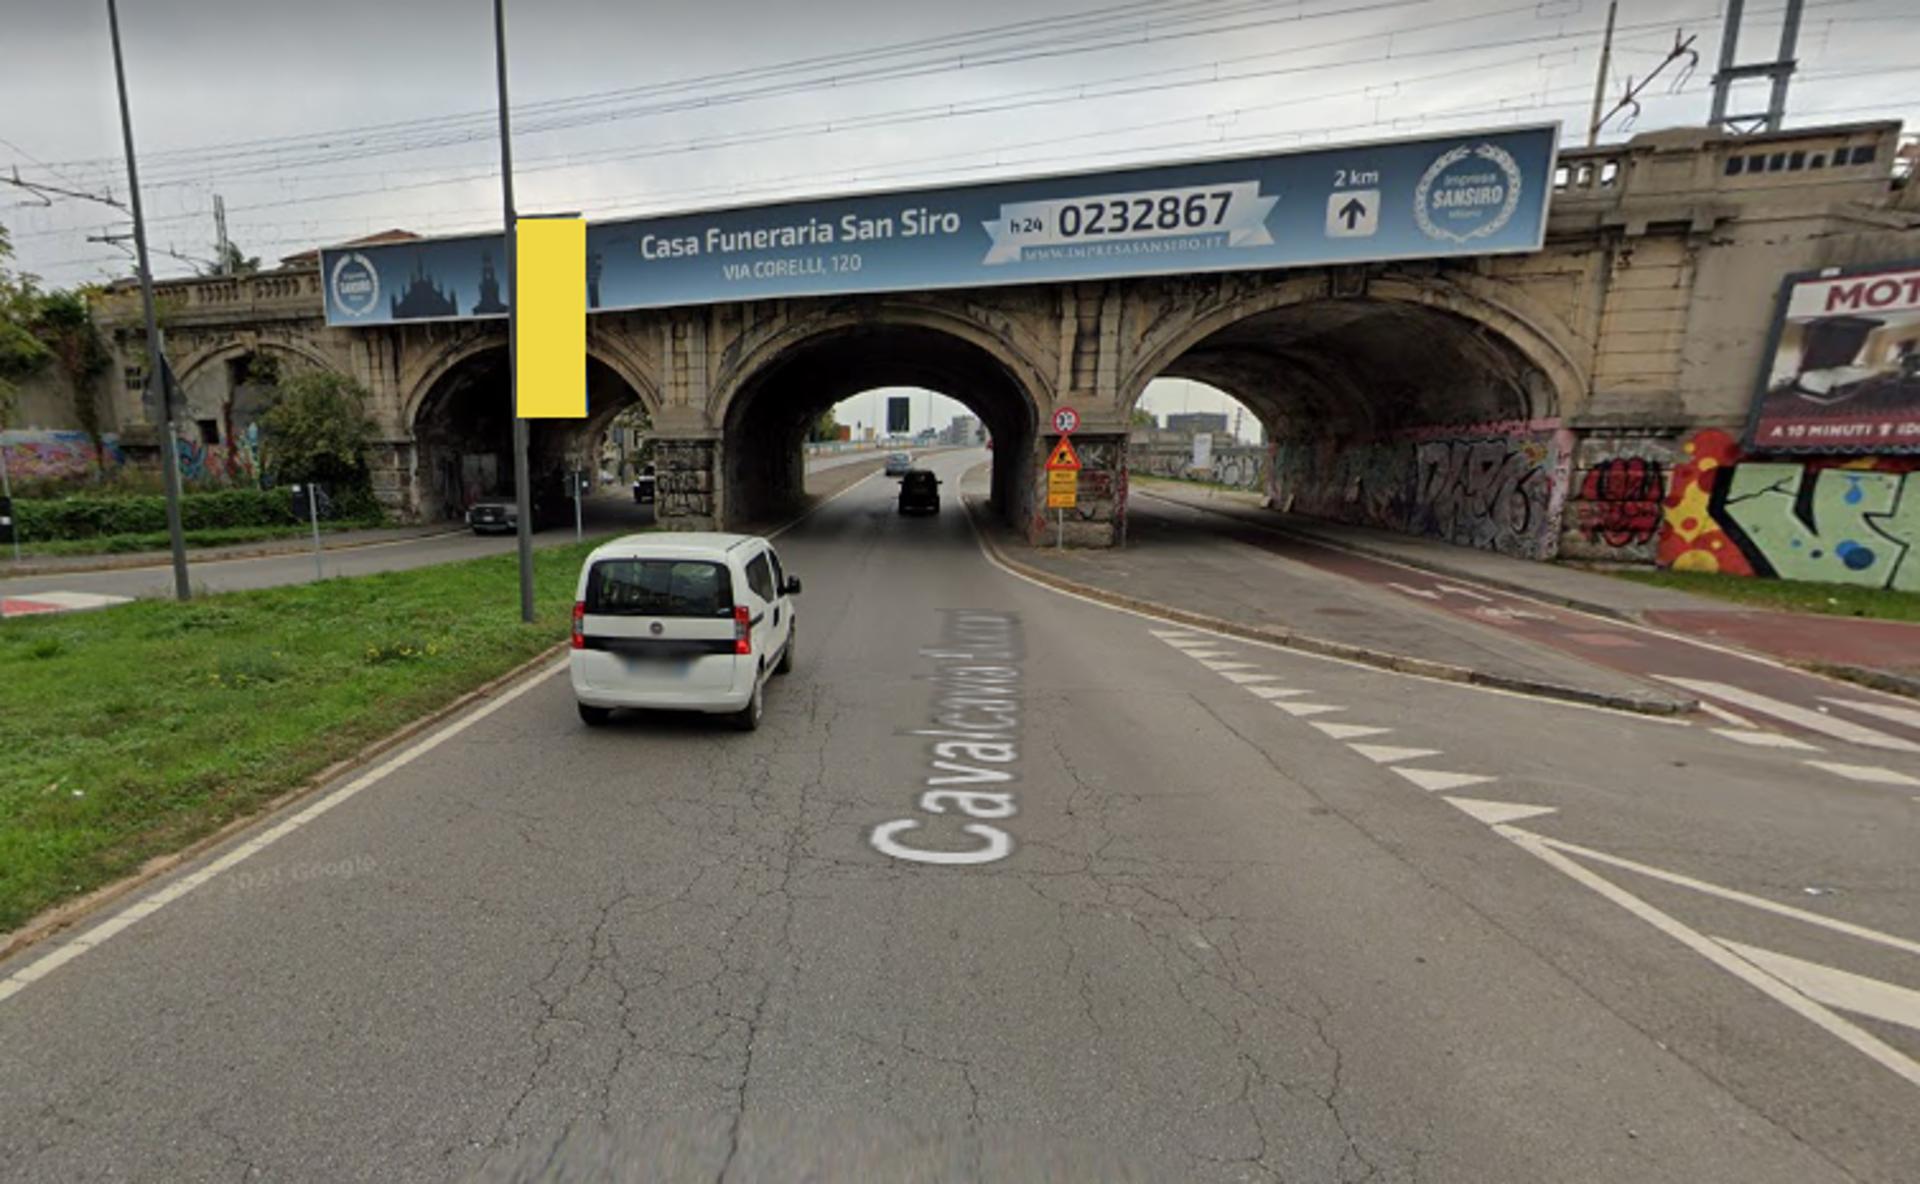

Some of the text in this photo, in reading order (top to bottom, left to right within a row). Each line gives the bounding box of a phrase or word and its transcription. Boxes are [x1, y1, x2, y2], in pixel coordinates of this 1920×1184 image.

[1334, 168, 1379, 187] 2 km
[1431, 184, 1504, 210] SANSIRO
[1010, 191, 1234, 238] h 24 0232867
[641, 208, 961, 261] Casa Funeraria San Siro
[723, 262, 750, 281] VIA
[832, 253, 862, 273] 120
[1771, 424, 1783, 437] A
[1808, 422, 1873, 437] MINUTI
